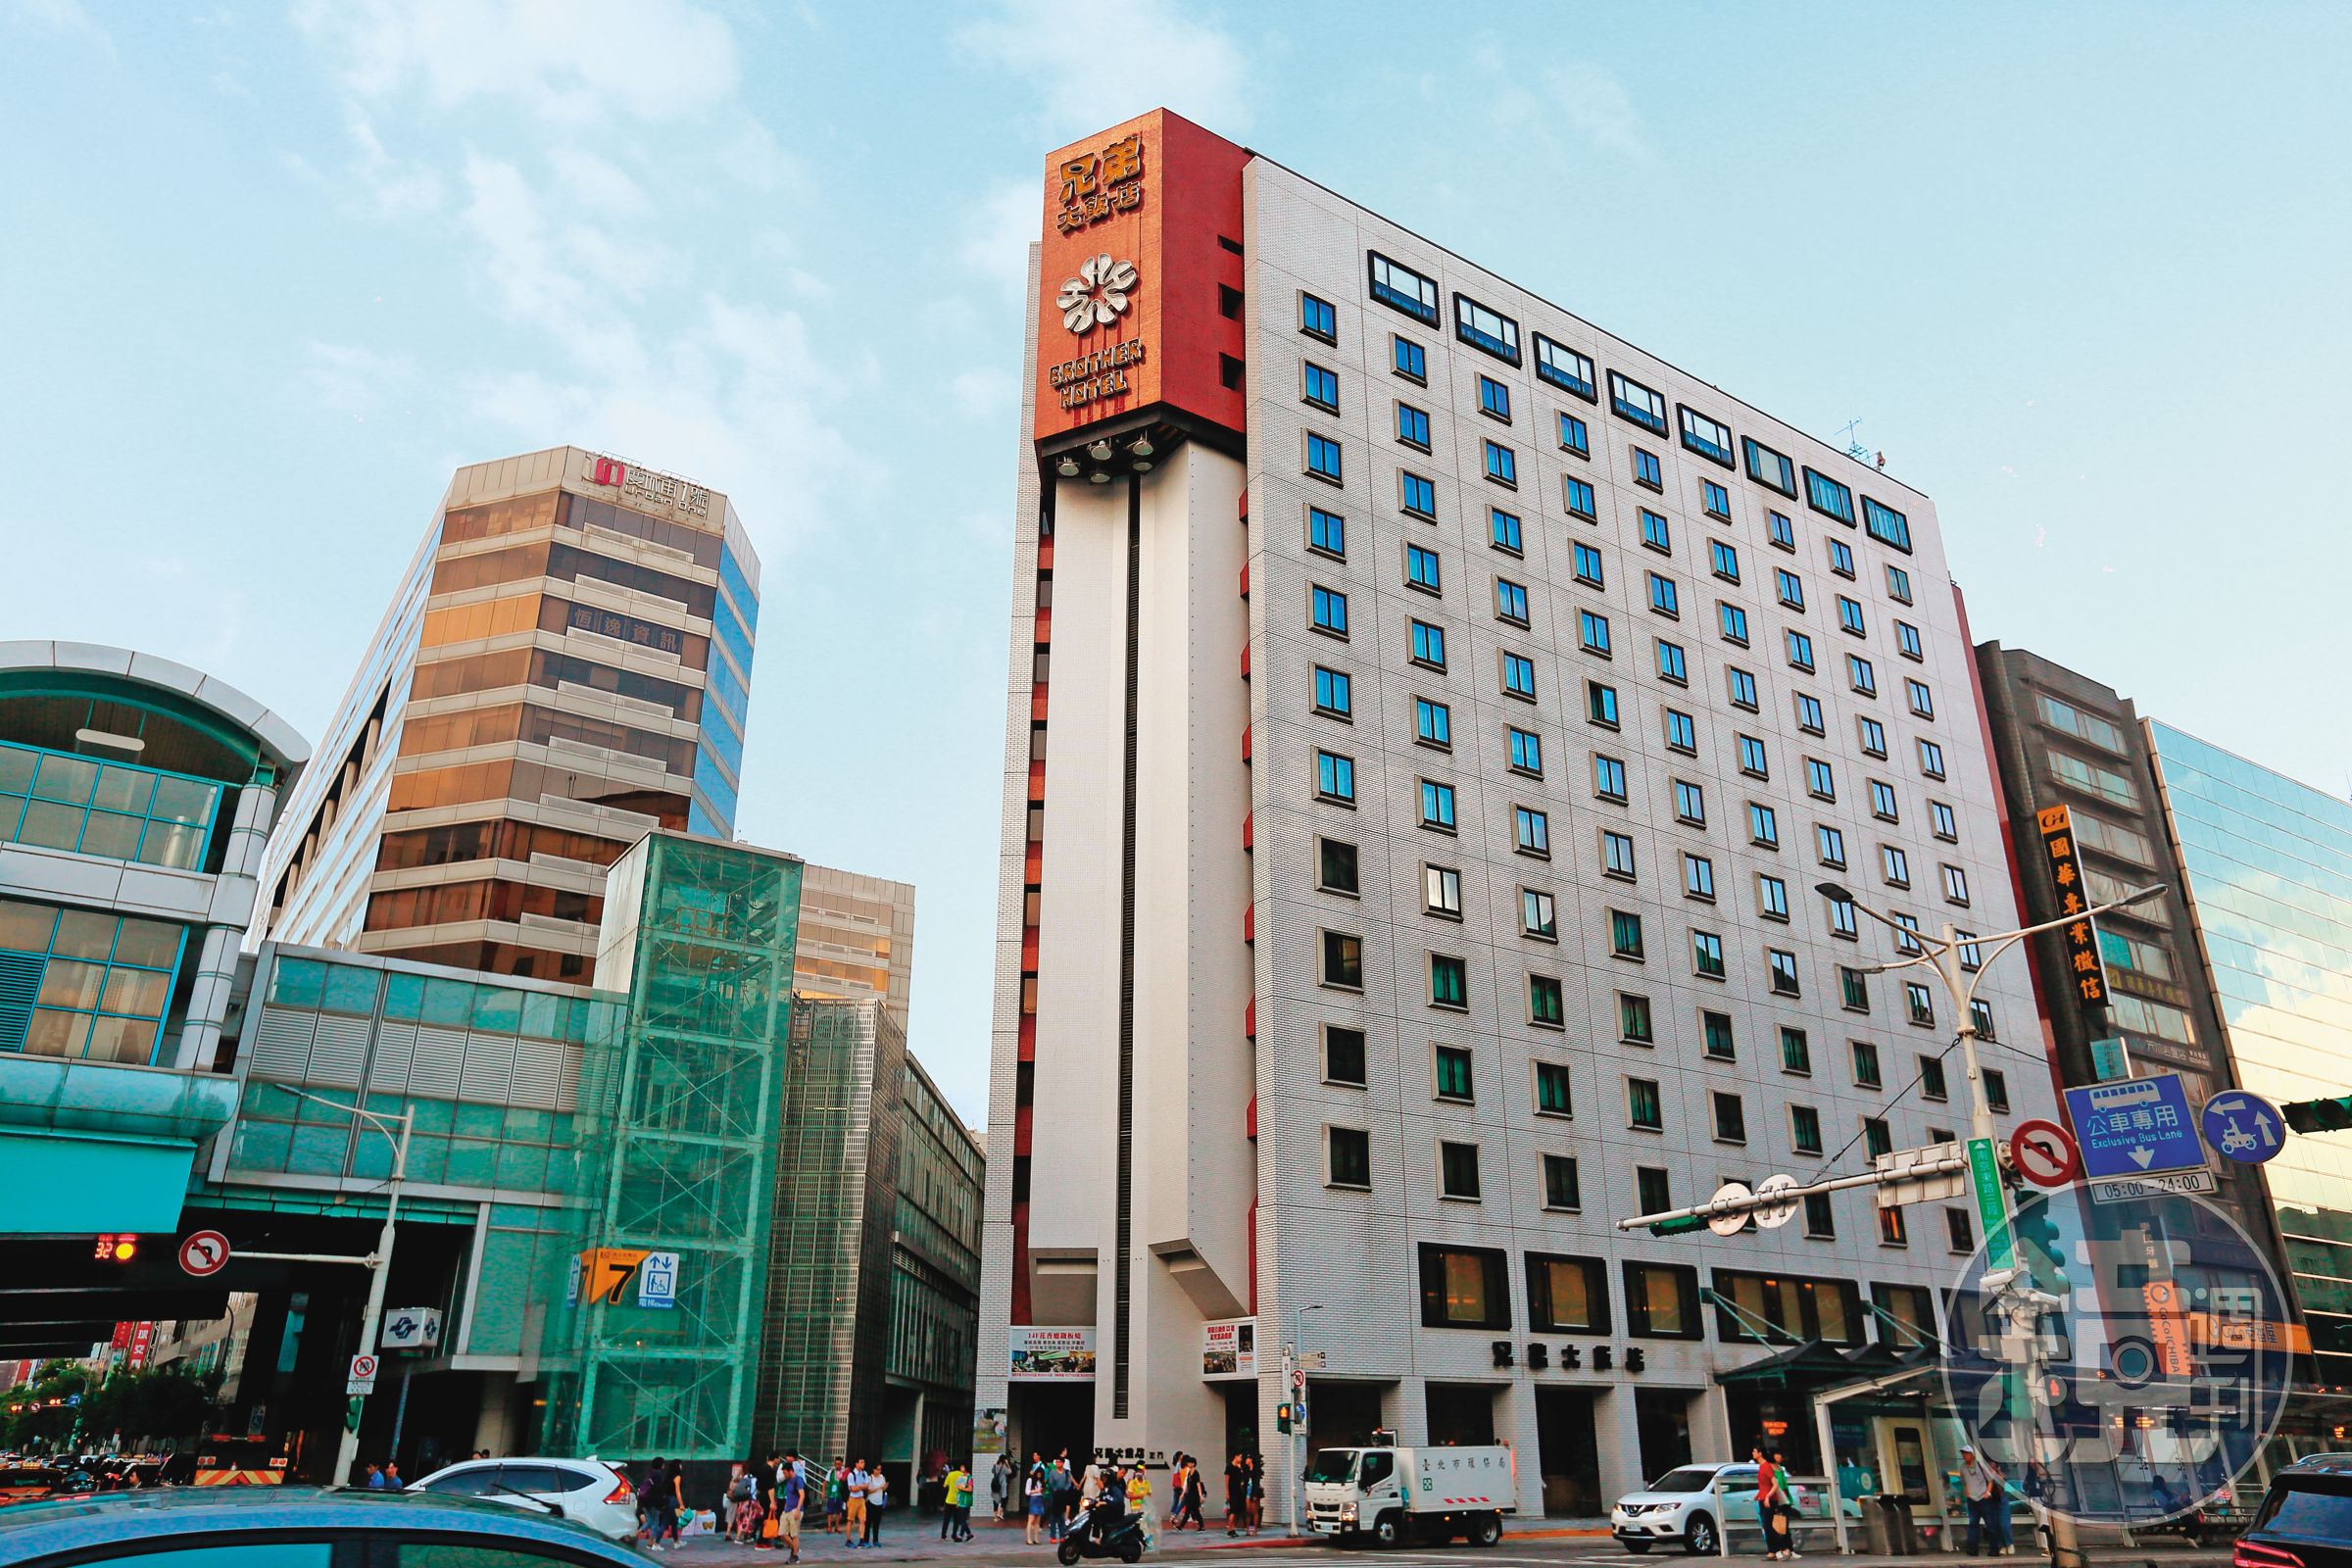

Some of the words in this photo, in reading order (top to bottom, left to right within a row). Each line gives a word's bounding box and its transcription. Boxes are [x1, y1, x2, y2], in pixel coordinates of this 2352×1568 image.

[1057, 135, 1142, 204] 兄弟
[1056, 182, 1141, 232] 大飯店
[1049, 338, 1142, 387] BROTHER
[1059, 369, 1127, 409] HOTEL
[2086, 1104, 2179, 1137] 公車專用
[2091, 1137, 2137, 1150] Exclusive
[2139, 1132, 2157, 1143] Bus
[2159, 1129, 2183, 1141] Lane
[2104, 1181, 2144, 1199] 05:00
[2158, 1175, 2200, 1193] 24:00
[609, 1263, 637, 1303] 7
[2167, 1336, 2180, 1373] ICHIBA
